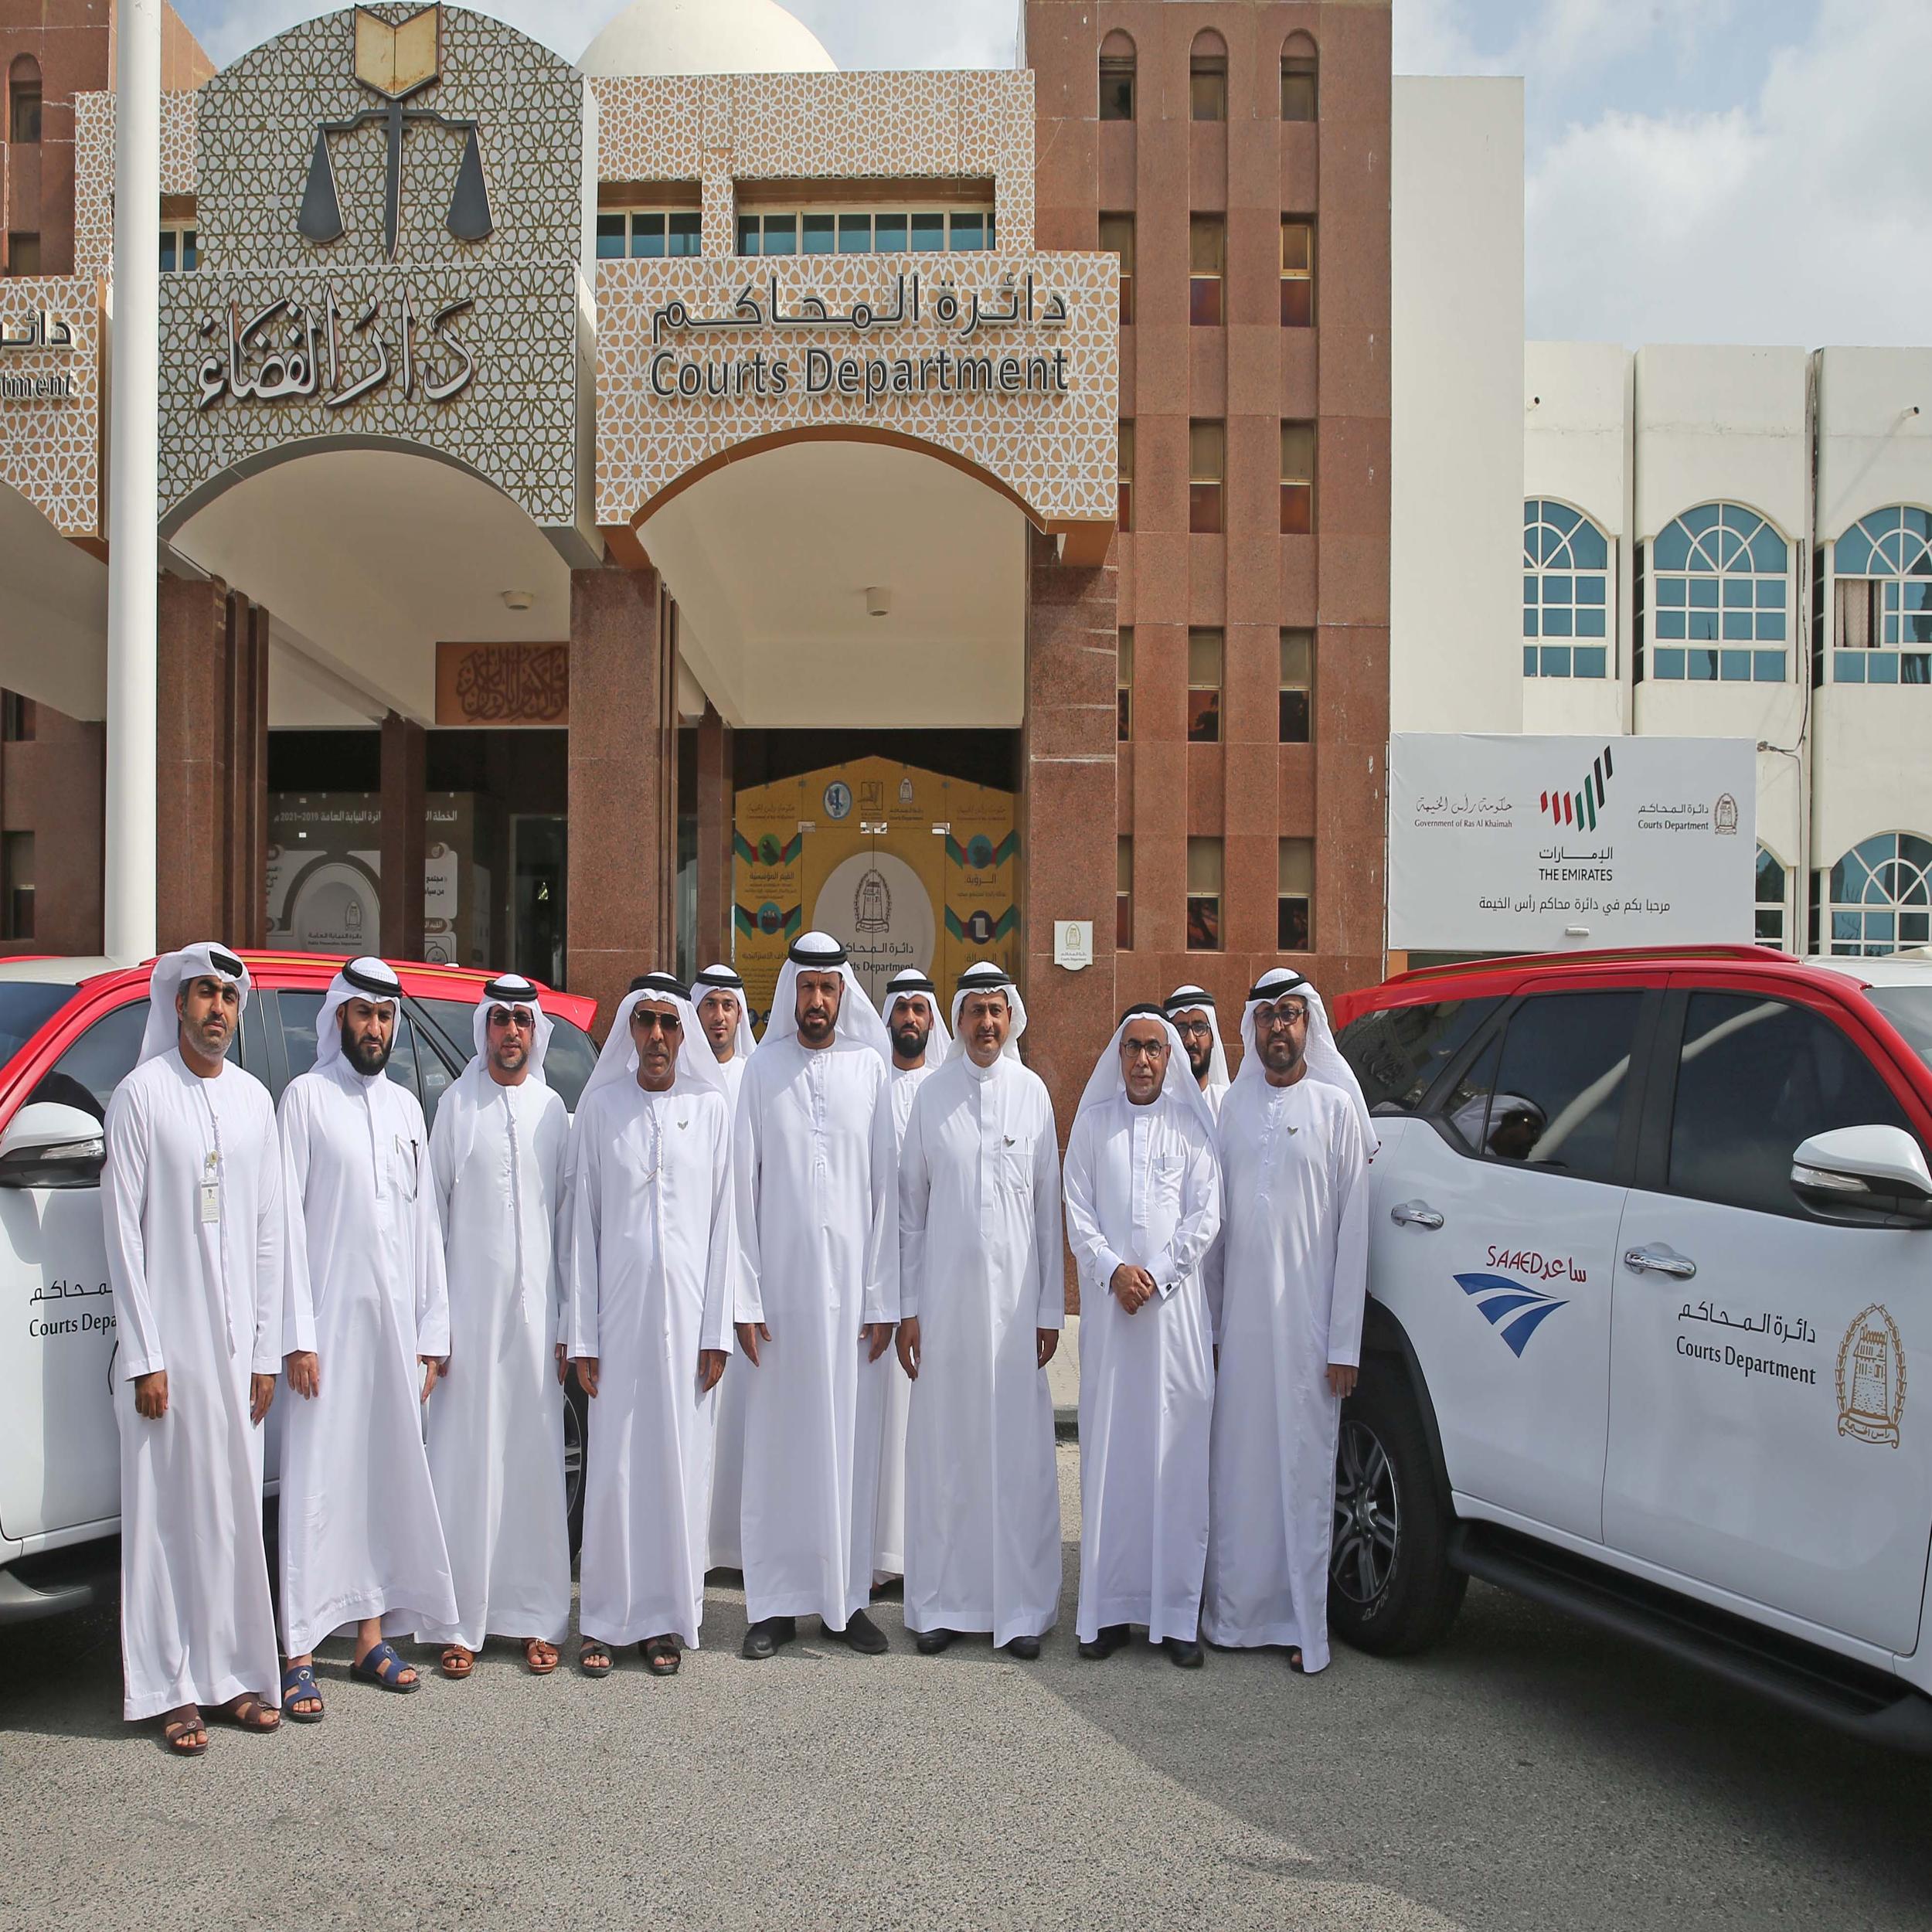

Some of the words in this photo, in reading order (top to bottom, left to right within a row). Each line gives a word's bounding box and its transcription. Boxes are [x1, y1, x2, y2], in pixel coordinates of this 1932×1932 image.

[651, 273, 920, 345] المحاكم
[935, 272, 1067, 338] دائرة
[0, 369, 73, 398] tment
[650, 351, 789, 396] Courts
[805, 348, 1069, 406] Department
[1638, 803, 1686, 814] المحاكم
[1687, 804, 1709, 816] دائرة
[1414, 819, 1454, 828] Government
[1485, 819, 1512, 828] Khaimah
[1638, 819, 1662, 829] Courts
[1665, 820, 1709, 832] Department
[1539, 845, 1614, 864] الإمارات
[1539, 868, 1560, 881] THE
[1562, 868, 1613, 881] EMIRATES
[1479, 896, 1510, 912] الخيمة
[1515, 894, 1536, 913] رأس
[1539, 896, 1570, 913] محاكم
[1574, 897, 1599, 913] دائرة
[1602, 899, 1620, 916] في
[1624, 898, 1642, 914] بكم
[1646, 899, 1671, 914] مرحبا
[845, 942, 887, 954] المحاك
[889, 942, 913, 957] دائرة
[1486, 1245, 1543, 1274] SAAED
[1540, 1257, 1587, 1283] ساعد
[29, 1280, 113, 1306] محاكم
[29, 1319, 78, 1338] Courts
[82, 1313, 117, 1335] Depa
[1678, 1301, 1771, 1333] المحاكم
[1774, 1315, 1816, 1343] دائرة
[1676, 1335, 1721, 1363] Courts
[1725, 1345, 1816, 1385] Department
